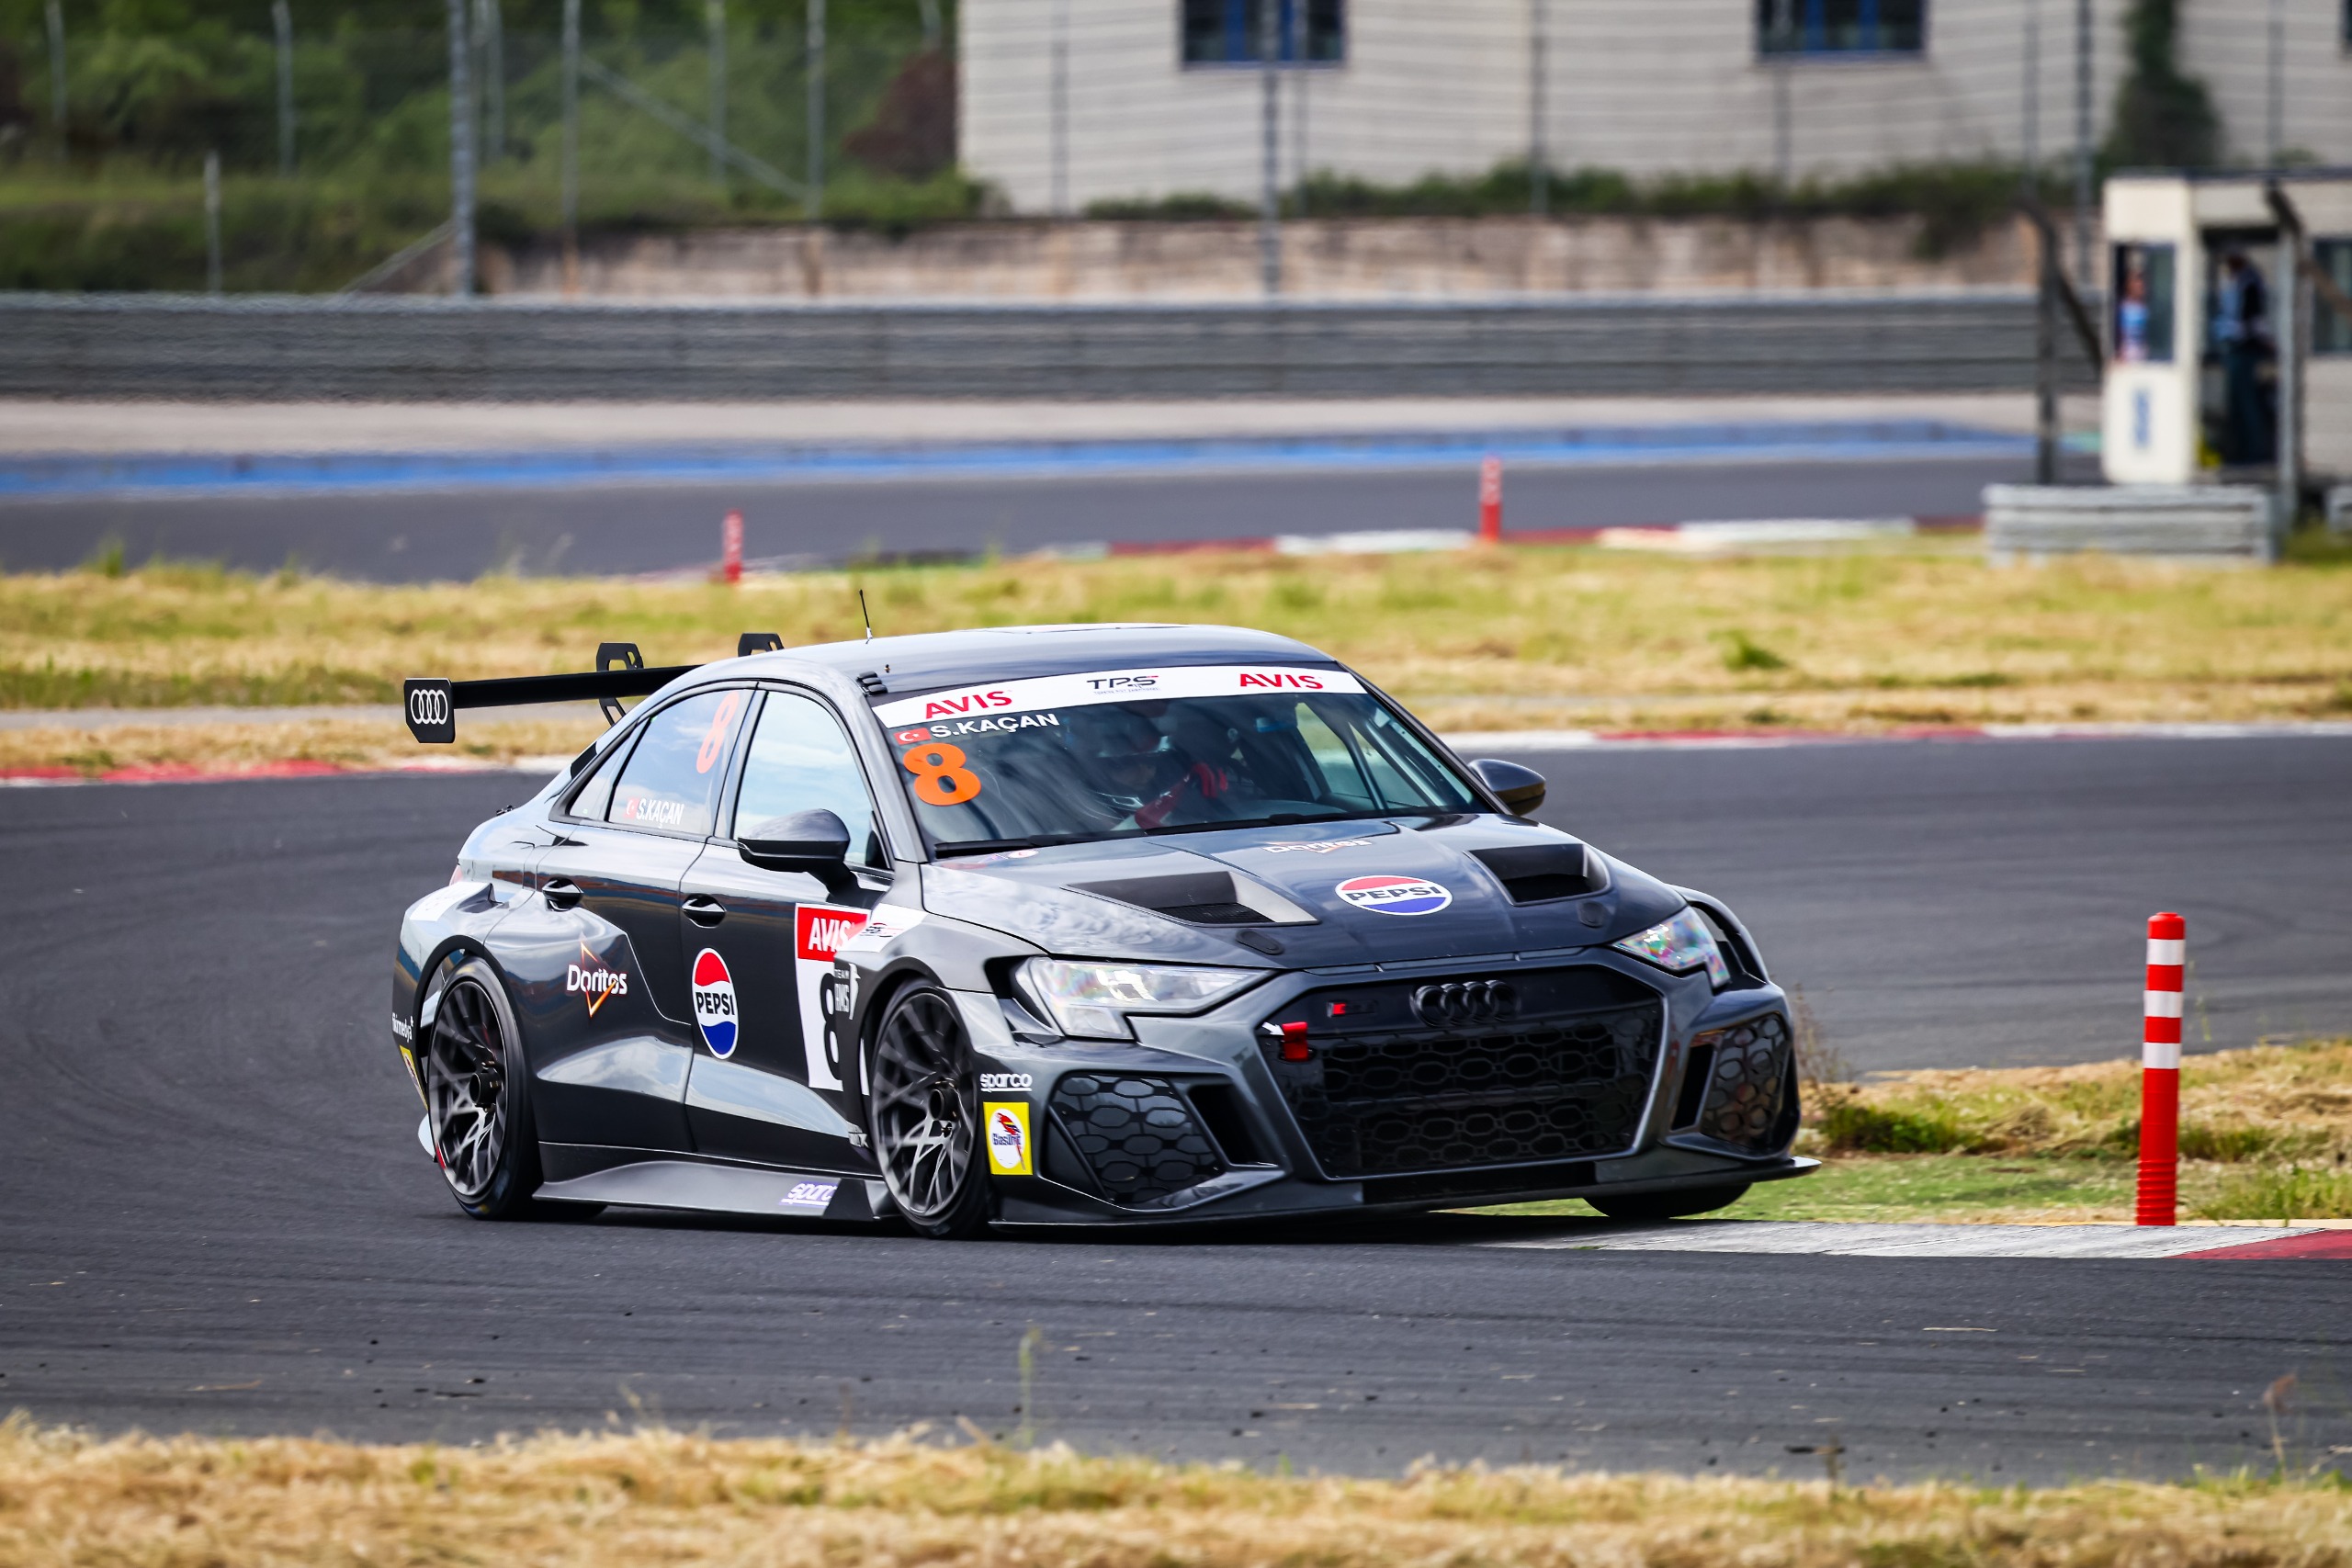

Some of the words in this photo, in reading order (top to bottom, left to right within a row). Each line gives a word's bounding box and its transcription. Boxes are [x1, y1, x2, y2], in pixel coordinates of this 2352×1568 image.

[1087, 675, 1159, 690] TPS
[1240, 673, 1323, 690] AVIS
[926, 691, 1012, 719] AVIS
[696, 690, 740, 773] 8
[930, 713, 1060, 739] S.KAÇAN
[902, 742, 982, 807] 8
[636, 798, 684, 829] S.KAÇAN
[1345, 886, 1442, 901] PEPSI
[808, 917, 853, 952] AVIS
[566, 964, 628, 995] Doritos
[695, 992, 735, 1015] PEPSI
[979, 1073, 1033, 1092] sparco
[783, 1182, 838, 1206] sparc
